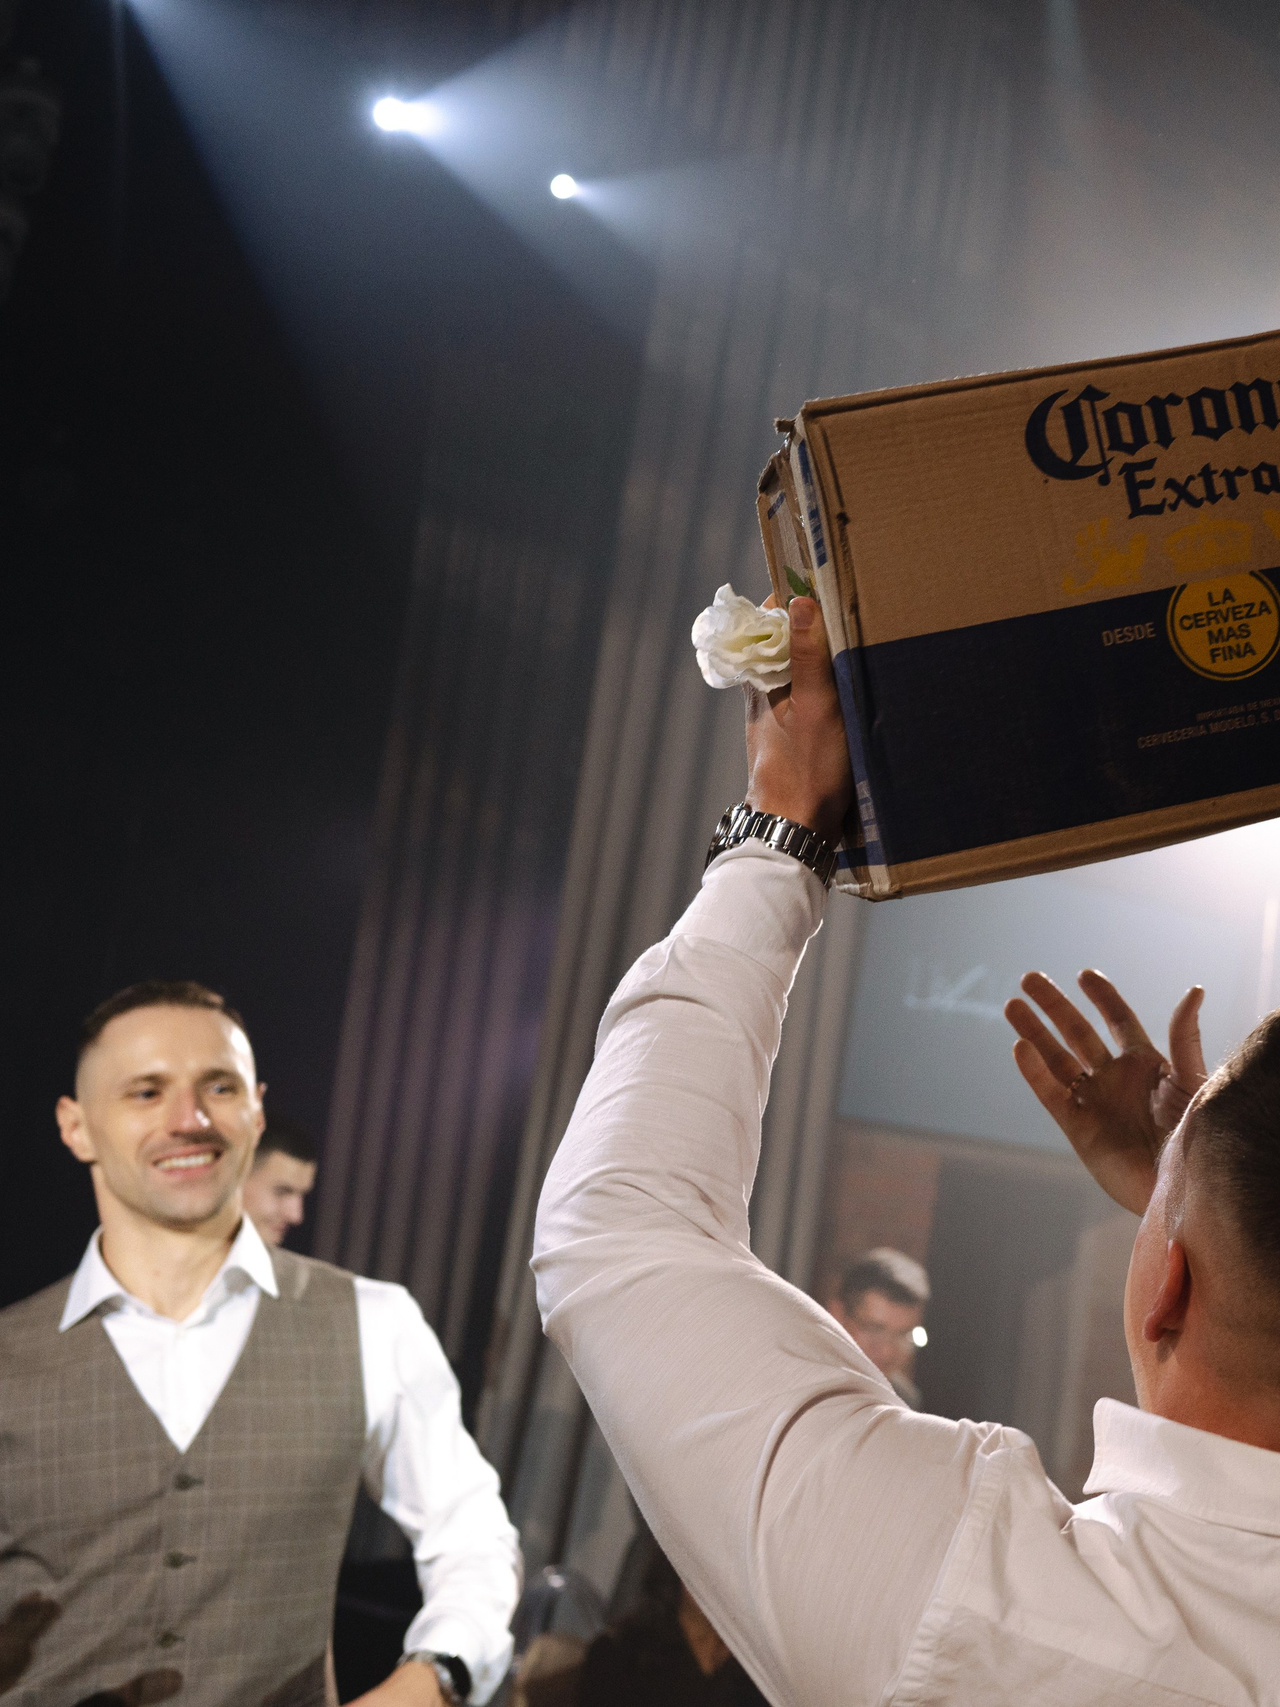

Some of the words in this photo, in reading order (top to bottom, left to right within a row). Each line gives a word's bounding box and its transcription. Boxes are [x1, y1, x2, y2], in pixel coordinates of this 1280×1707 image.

[1207, 587, 1236, 607] LA
[1179, 600, 1273, 631] CERVEZA
[1102, 621, 1158, 646] DESDE
[1207, 623, 1251, 646] MAS
[1209, 641, 1257, 664] FINA
